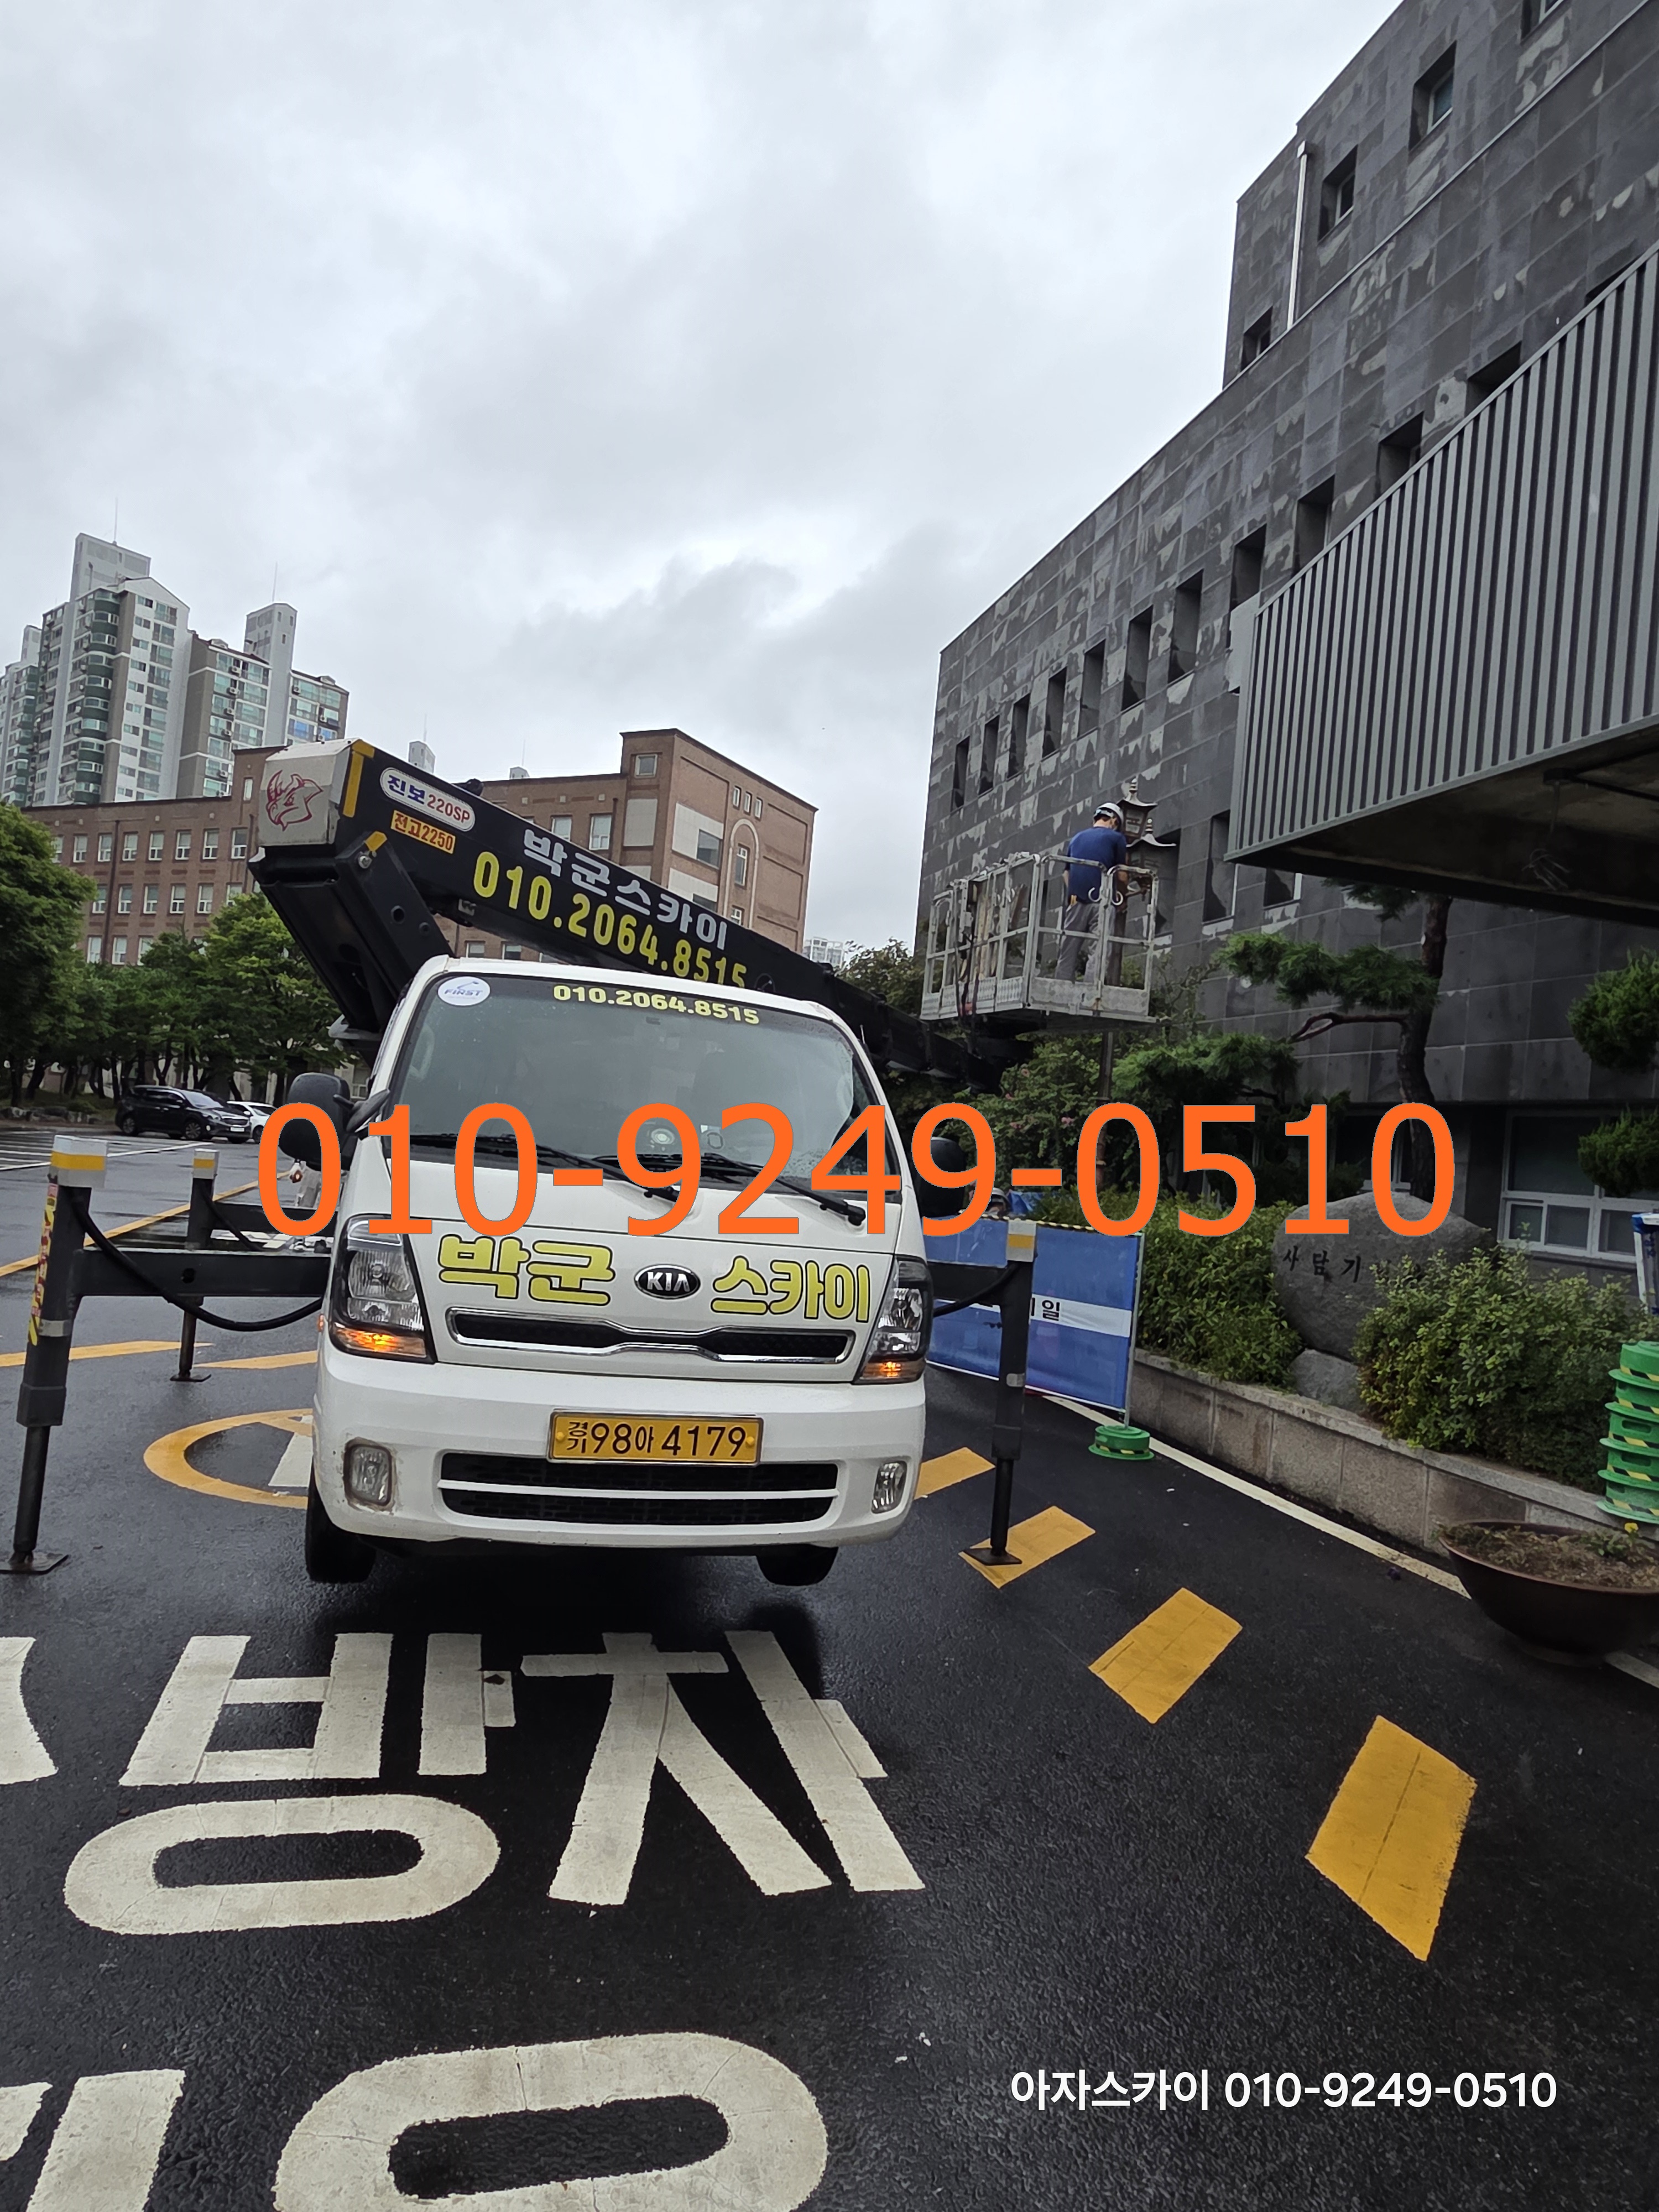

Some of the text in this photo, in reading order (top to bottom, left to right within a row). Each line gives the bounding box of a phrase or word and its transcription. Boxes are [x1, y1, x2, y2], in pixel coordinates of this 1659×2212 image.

[388, 775, 470, 823] 진보 220SP
[394, 813, 453, 851] 전고2250
[524, 830, 727, 950] 박군스카이
[474, 852, 747, 988] 010.2064.8515
[554, 985, 759, 1024] 010.2064.8515
[438, 1234, 870, 1323] 박군 KIA 스카이
[661, 1425, 747, 1457] 4179
